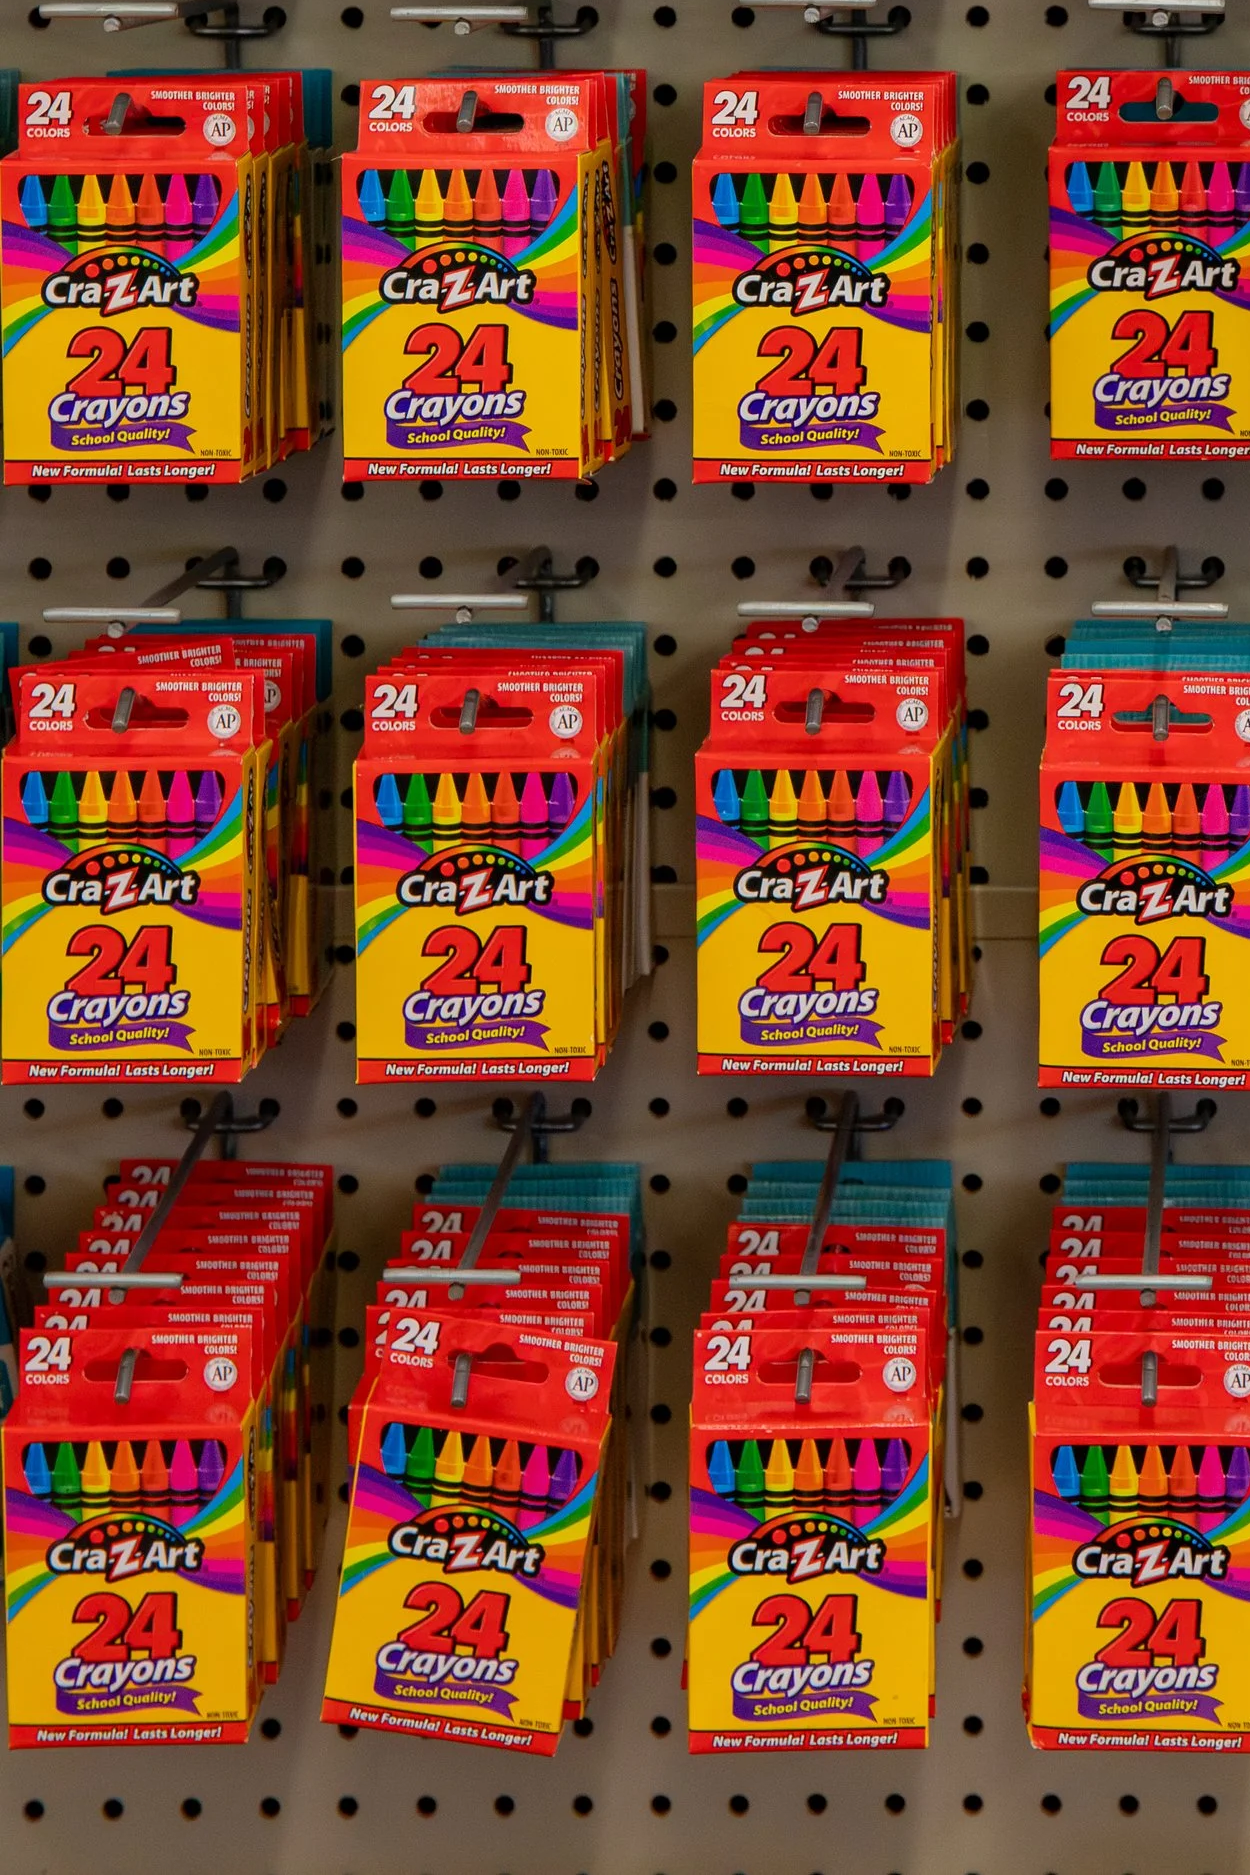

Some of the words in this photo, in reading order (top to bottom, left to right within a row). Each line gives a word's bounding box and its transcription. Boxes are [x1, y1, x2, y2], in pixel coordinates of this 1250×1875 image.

[494, 84, 537, 95] SMOOTHER
[539, 85, 580, 96] BRIGHTER
[26, 91, 72, 126] 24
[546, 96, 580, 106] COLORS!
[26, 127, 72, 139] COLORS
[1111, 308, 1219, 377] 24
[1094, 373, 1229, 407] Crayons
[49, 391, 189, 427] Crayons
[760, 429, 804, 445] School
[806, 428, 860, 442] Quality!
[889, 450, 922, 458] NON-TOXIC
[1057, 683, 1104, 718] 24
[1057, 719, 1103, 732] COLORS
[421, 924, 532, 995] 24
[404, 989, 543, 1025] Crayons
[1081, 1000, 1221, 1035] Crayons
[69, 1029, 114, 1045] School
[115, 1027, 169, 1041] Quality!
[721, 1059, 751, 1072] New
[752, 1060, 812, 1072] Formula!
[816, 1061, 850, 1072] Lasts
[852, 1061, 904, 1074] Longer!
[390, 1317, 440, 1356] 24
[830, 1334, 874, 1344] SMOOTHER
[876, 1334, 918, 1345] BRIGHTER
[883, 1345, 917, 1355] COLORS!
[389, 1352, 435, 1370] COLORS
[376, 1642, 518, 1682] Crayons
[1078, 1662, 1217, 1697] Crayons
[1098, 1700, 1143, 1715] School
[1144, 1700, 1198, 1712] Quality!
[36, 1730, 67, 1743] New
[68, 1728, 129, 1742] Formula!
[133, 1728, 168, 1740] Lasts
[170, 1726, 222, 1740] Longer!
